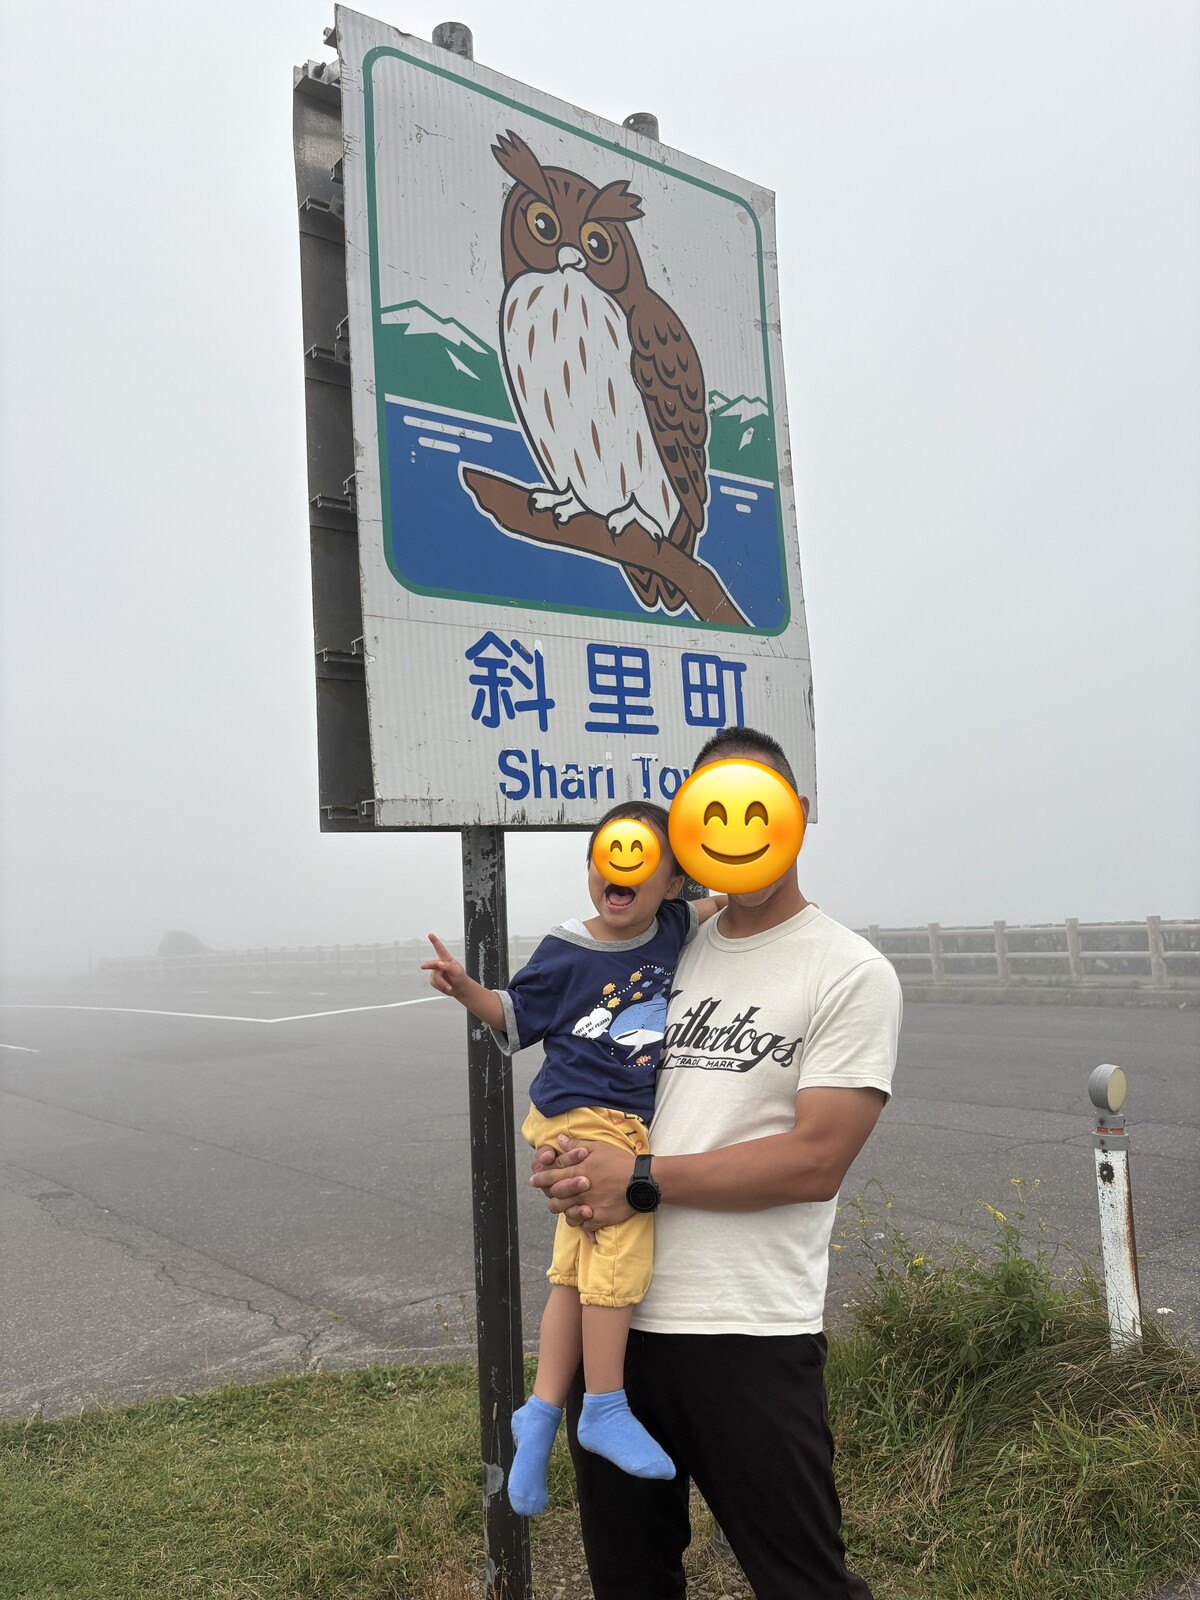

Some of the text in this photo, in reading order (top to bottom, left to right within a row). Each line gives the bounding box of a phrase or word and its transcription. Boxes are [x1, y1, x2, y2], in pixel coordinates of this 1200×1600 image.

[465, 631, 747, 735] 斜里町
[498, 748, 691, 801] Shari To
[663, 990, 803, 1067] athertogs
[706, 1060, 735, 1069] MARK
